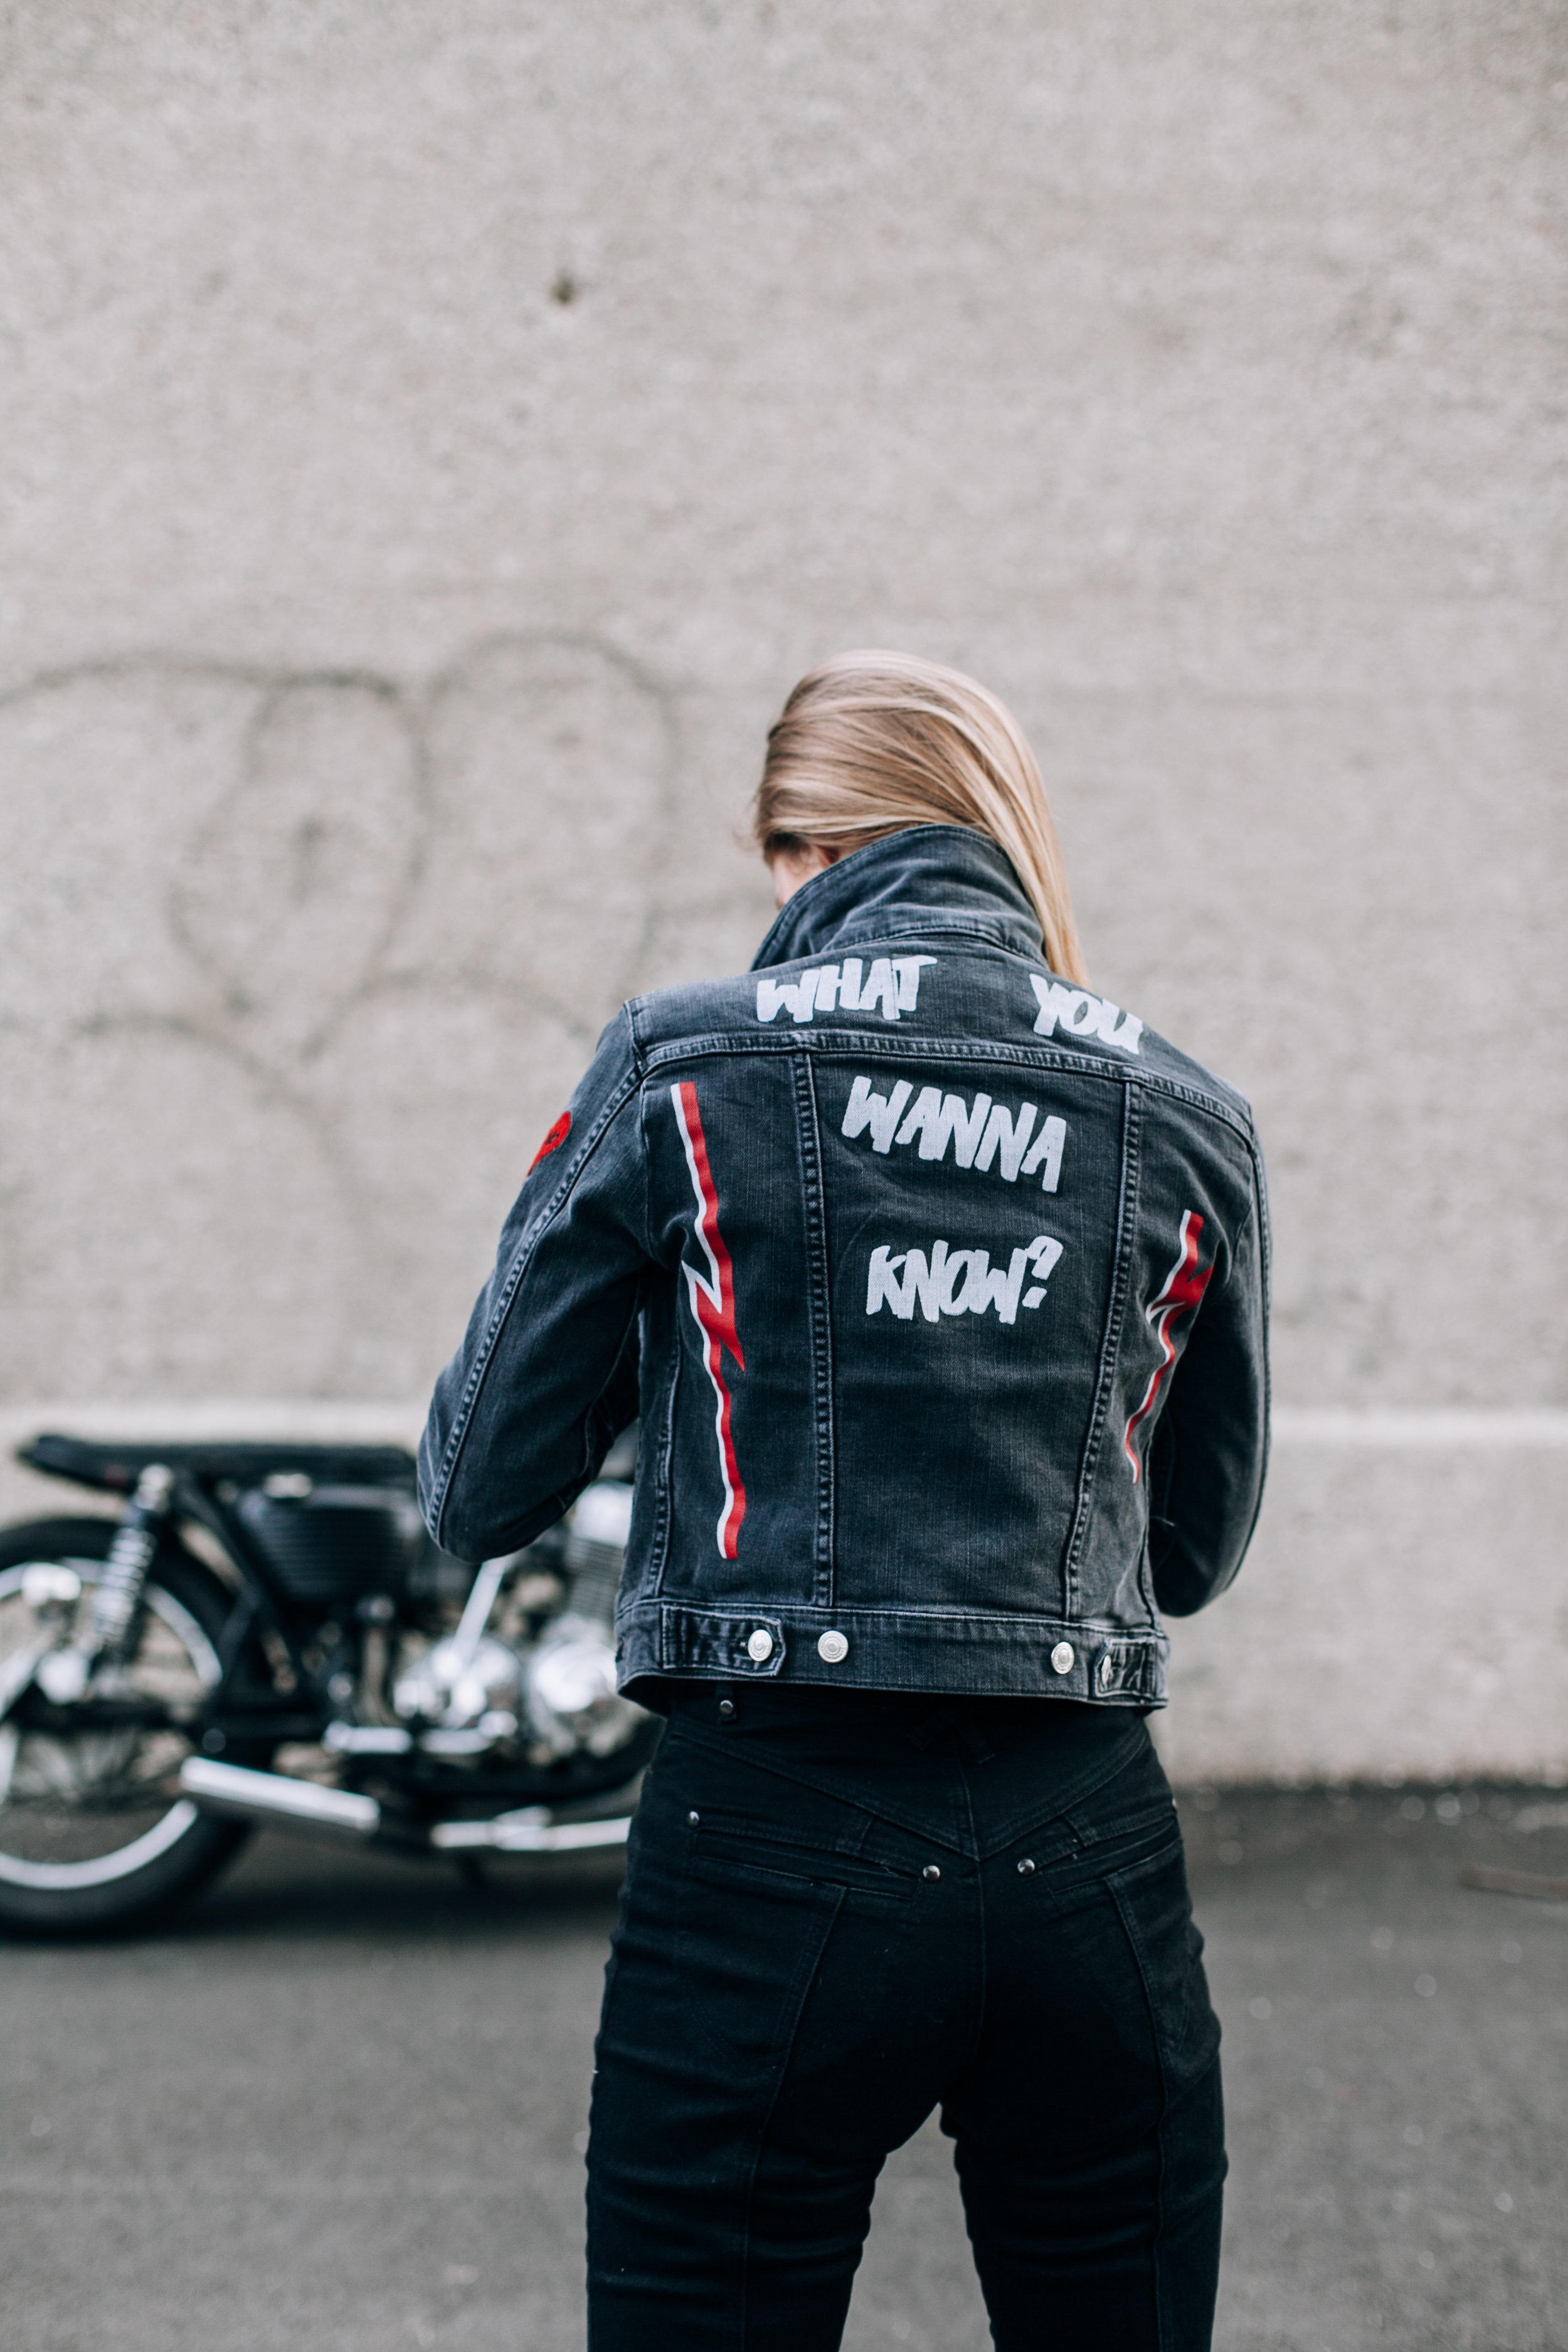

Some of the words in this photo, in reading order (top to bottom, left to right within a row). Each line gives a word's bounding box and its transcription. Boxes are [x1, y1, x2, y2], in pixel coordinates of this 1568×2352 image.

[756, 955, 938, 1023] WHAT
[1030, 973, 1143, 1055] YOU
[842, 1076, 1066, 1192] WANNA
[866, 1236, 1063, 1325] KNOW?
